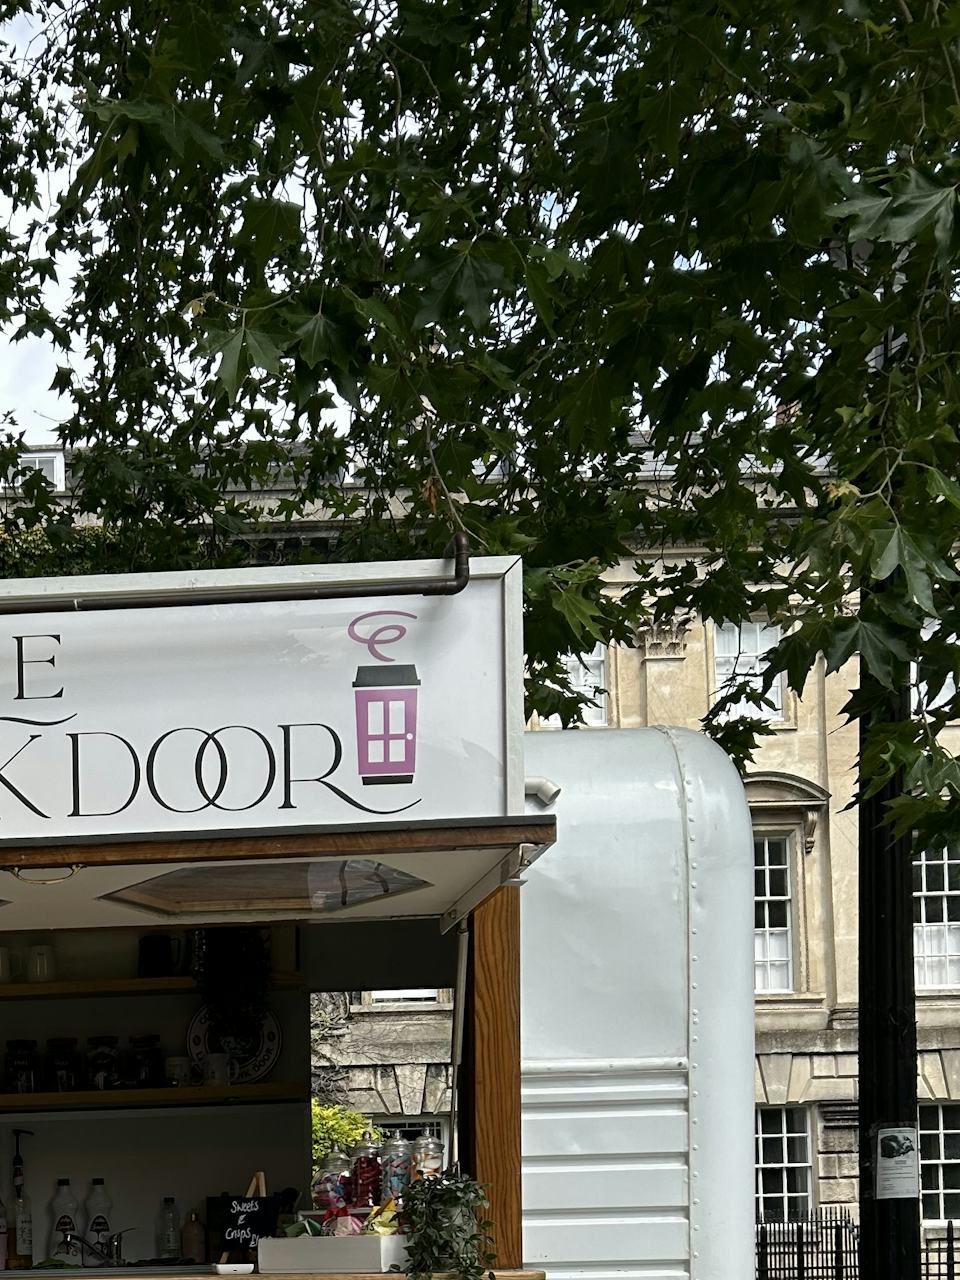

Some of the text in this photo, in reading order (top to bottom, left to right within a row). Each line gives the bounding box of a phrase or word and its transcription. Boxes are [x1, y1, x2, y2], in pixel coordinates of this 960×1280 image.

[67, 722, 422, 820] DOOR
[230, 1200, 259, 1213] Sweets
[225, 1227, 252, 1243] Crisps
